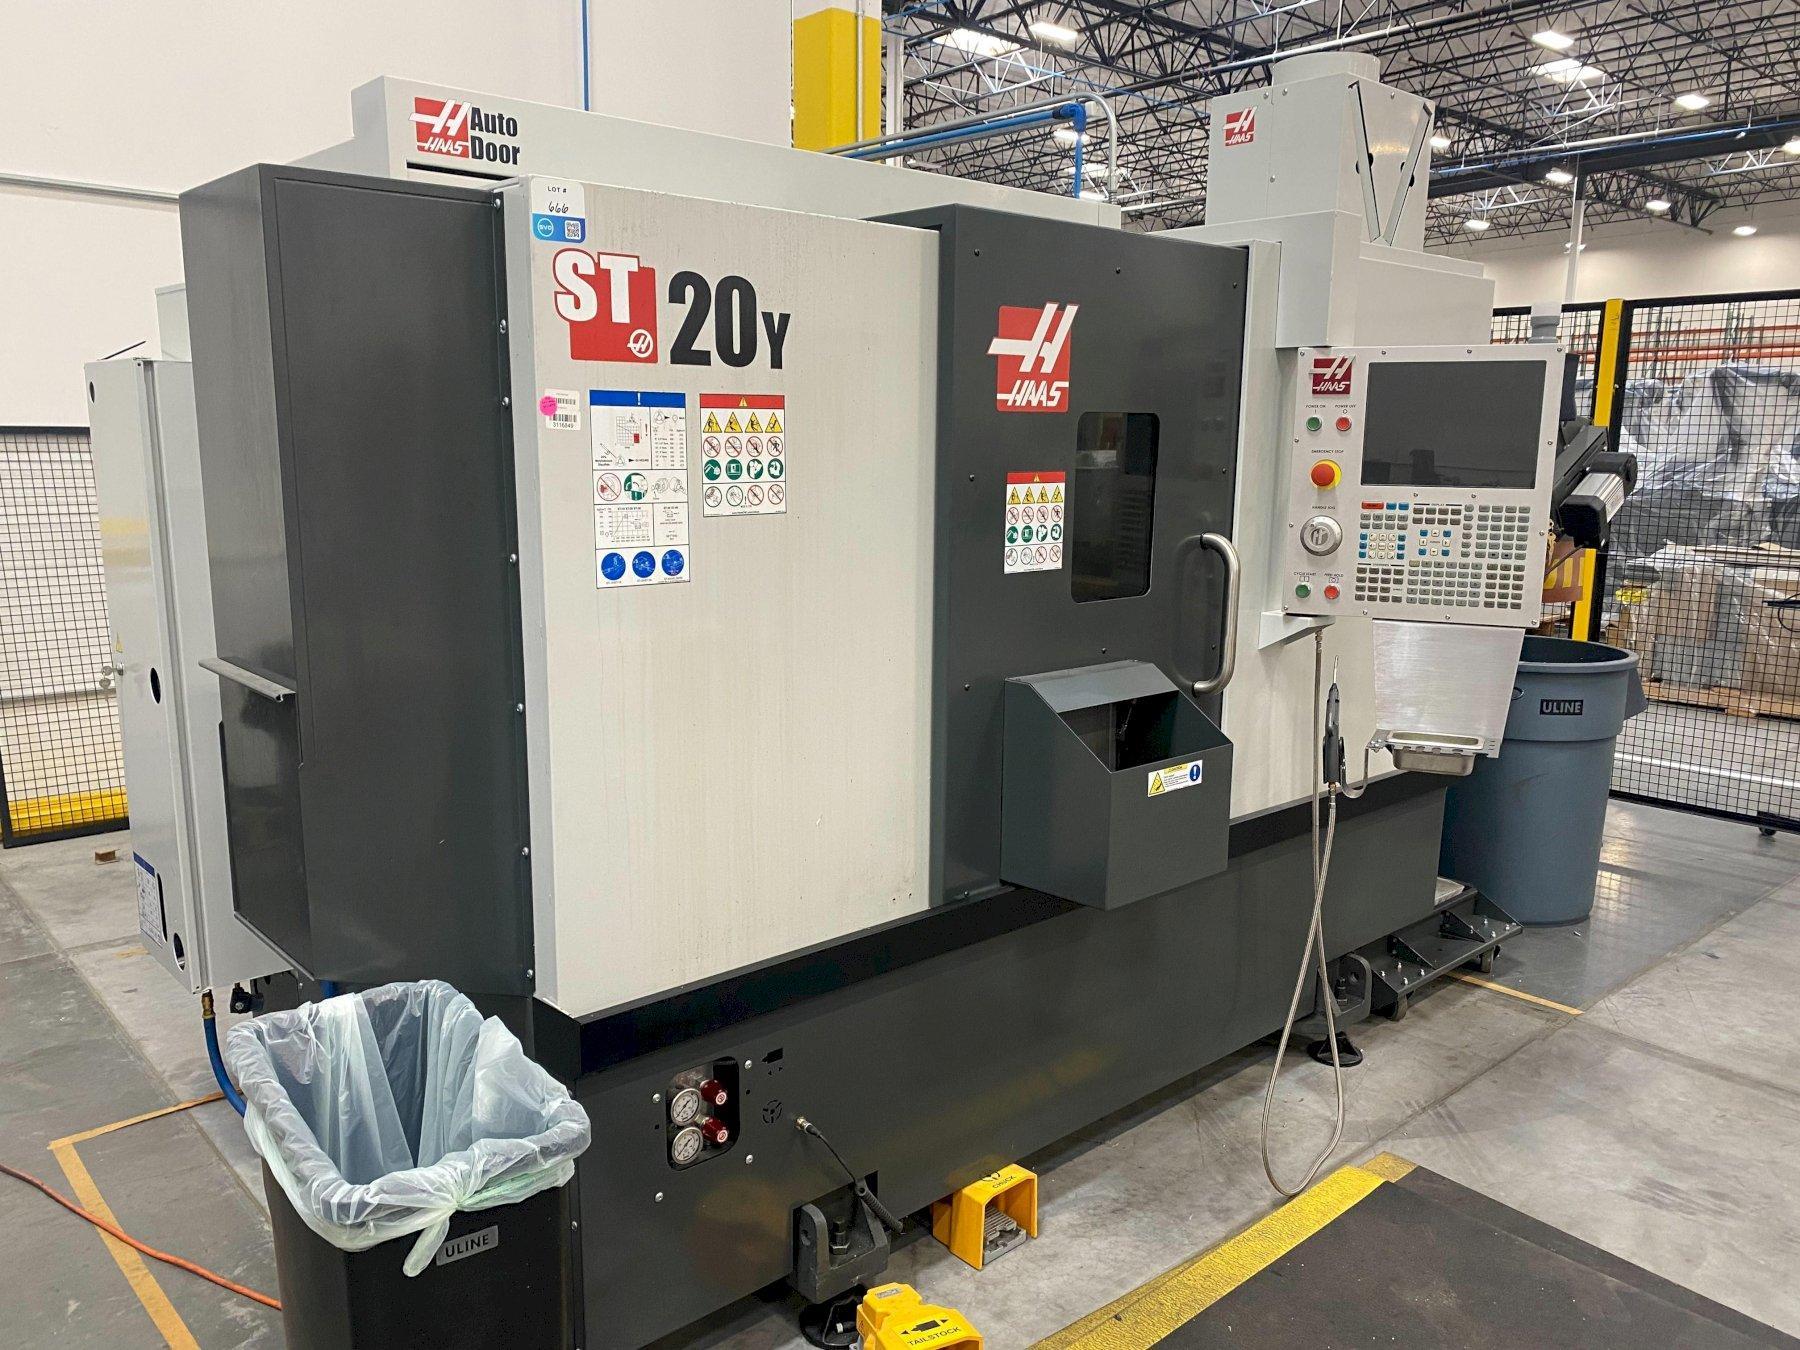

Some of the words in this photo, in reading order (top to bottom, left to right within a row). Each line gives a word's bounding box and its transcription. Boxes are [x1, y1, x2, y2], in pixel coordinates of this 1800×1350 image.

[470, 106, 518, 137] Auto
[417, 137, 470, 155] HAAS
[1225, 131, 1255, 145] HAAS
[470, 135, 521, 166] Door
[548, 200, 569, 214] 666
[554, 248, 641, 324] ST
[668, 270, 792, 370] 20Y
[997, 379, 1069, 407] HAAS
[1312, 381, 1350, 392] HAAS
[1542, 701, 1582, 714] ULINE
[992, 1174, 1018, 1189] CHUCK
[445, 1234, 490, 1258] ULINE
[906, 1326, 963, 1347] TAILSTOCK
